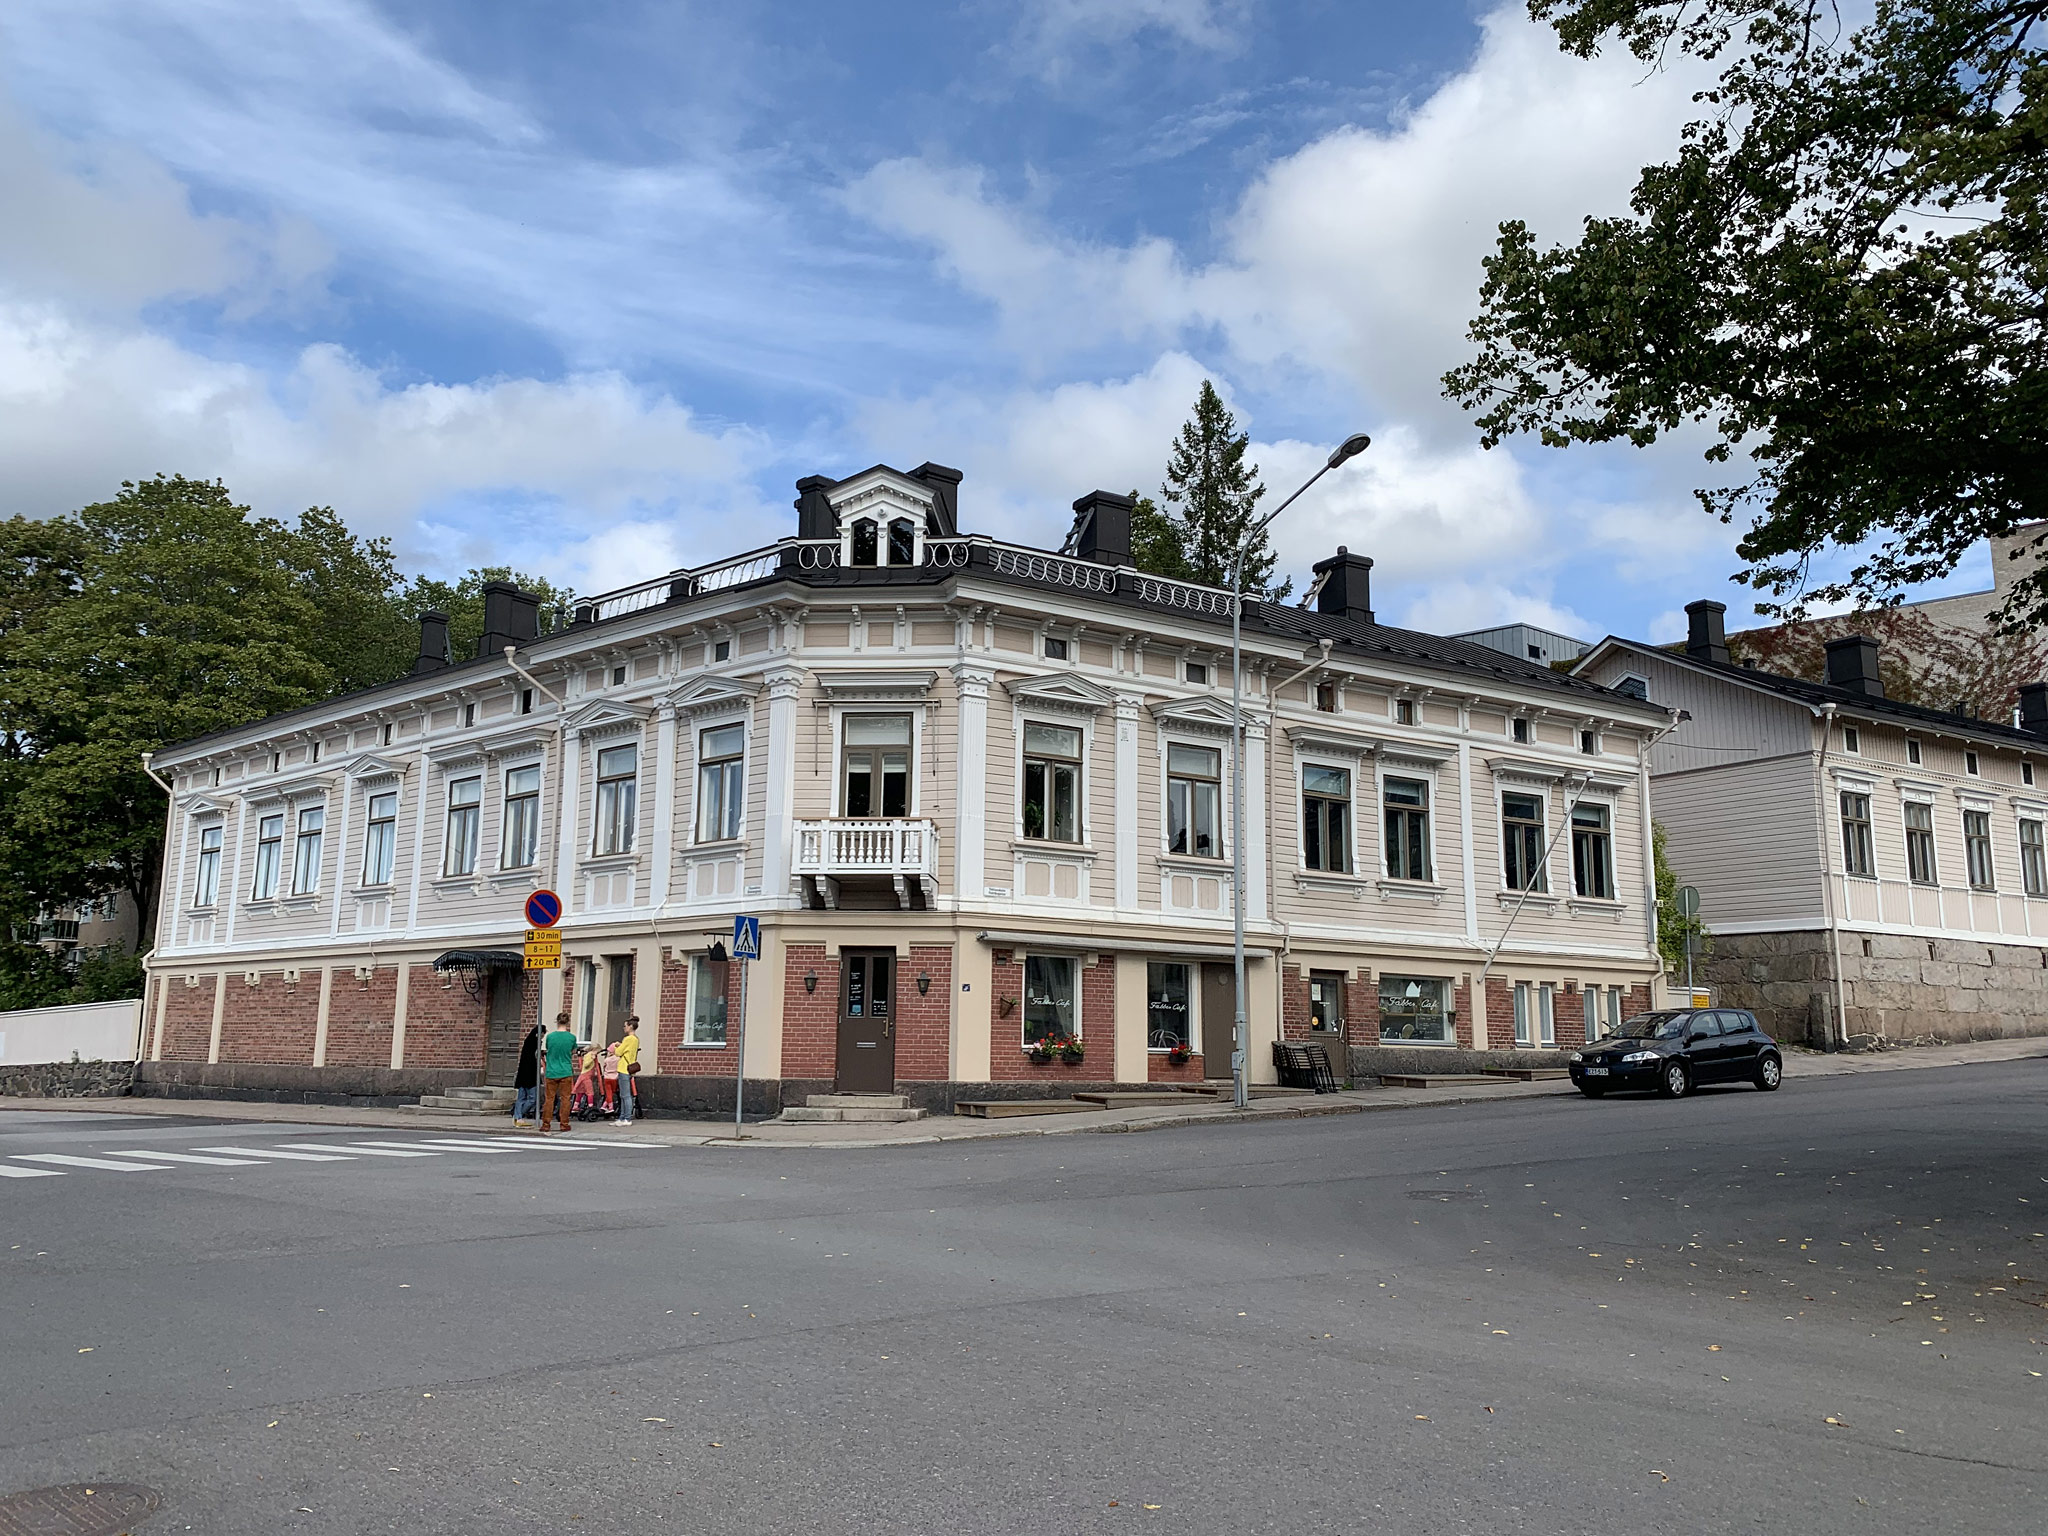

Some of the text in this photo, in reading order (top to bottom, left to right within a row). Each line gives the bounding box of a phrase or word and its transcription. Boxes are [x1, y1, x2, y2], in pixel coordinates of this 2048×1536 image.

[536, 932, 559, 940] 30 min
[534, 958, 544, 966] 20
